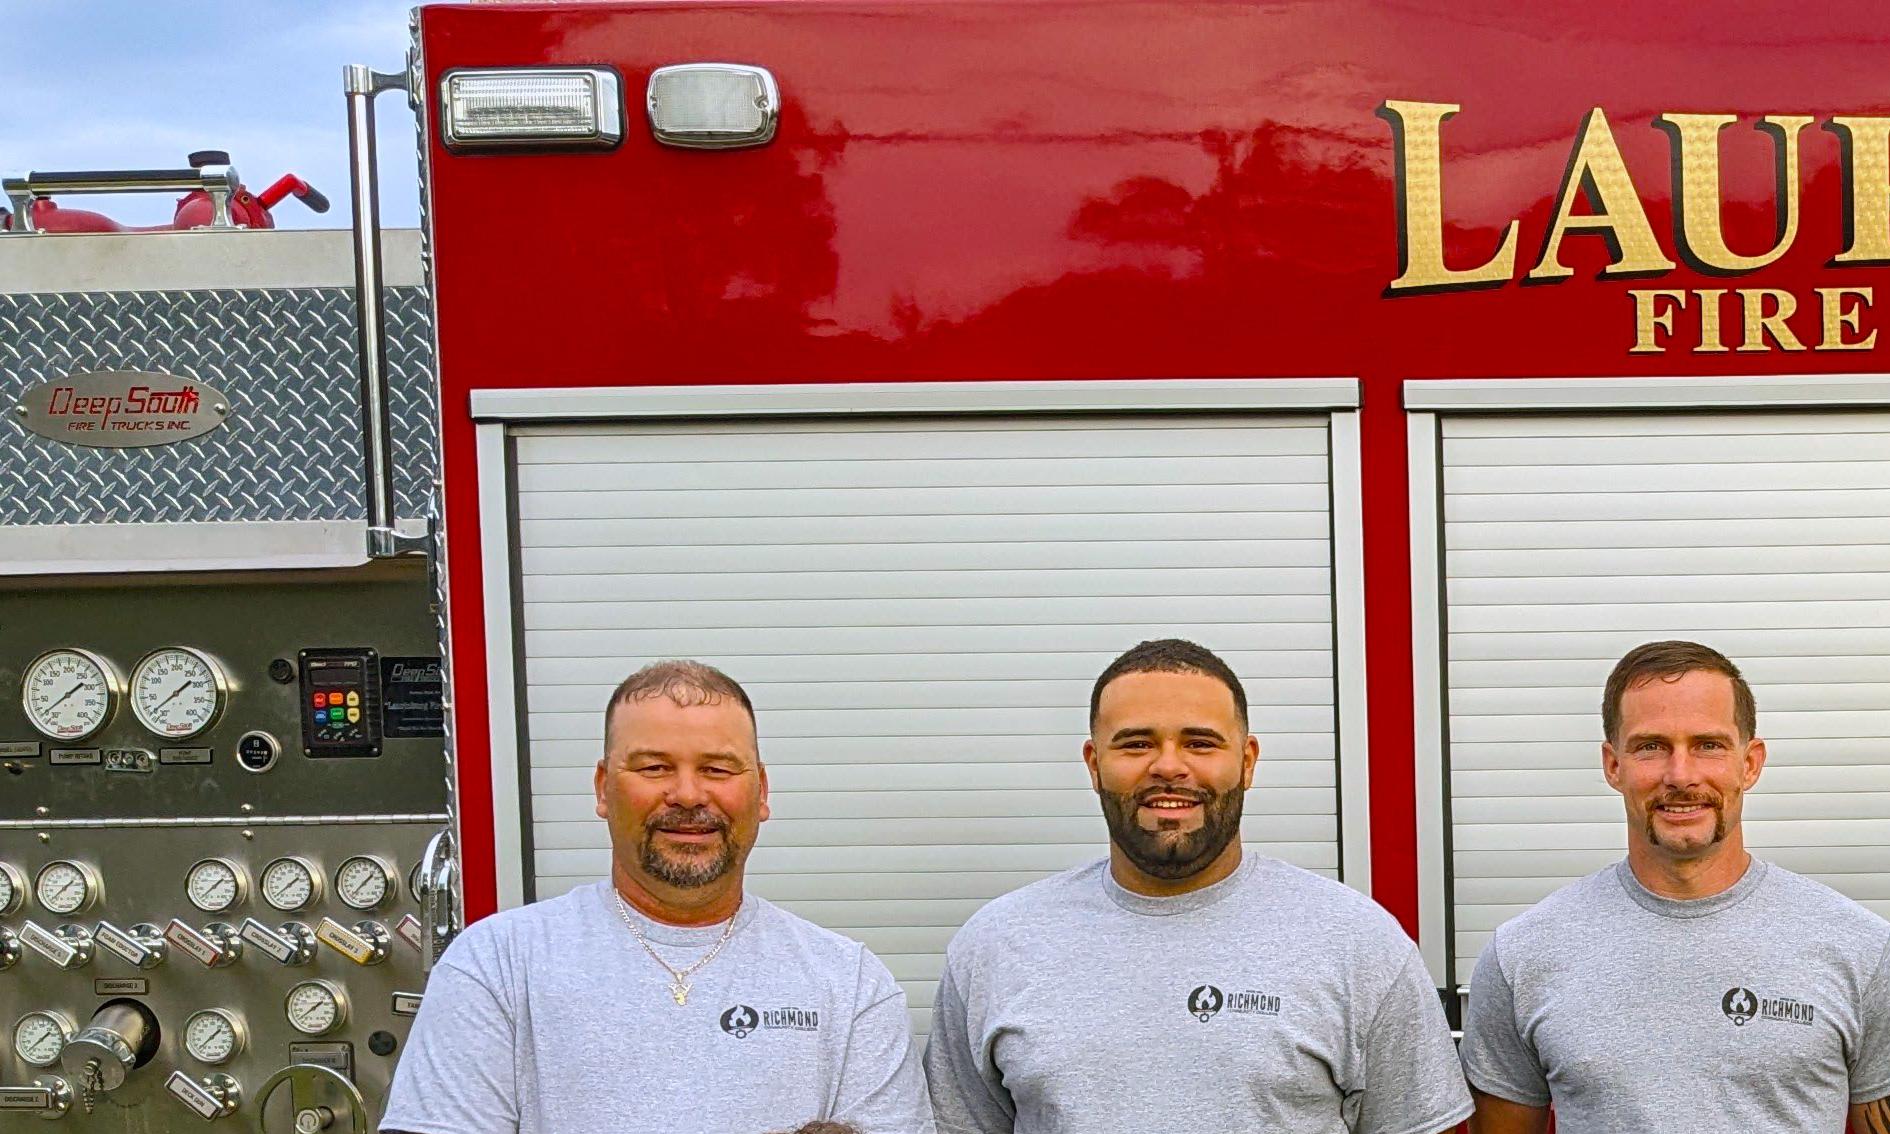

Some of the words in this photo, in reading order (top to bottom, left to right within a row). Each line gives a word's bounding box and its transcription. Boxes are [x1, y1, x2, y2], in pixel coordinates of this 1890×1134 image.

[1628, 286, 1878, 355] FIRE
[48, 387, 122, 430] Deep
[124, 386, 199, 414] South
[68, 422, 95, 431] FIRE
[111, 421, 165, 431] TRUCKS
[167, 420, 191, 431] INC.
[1227, 993, 1280, 1012] RICHMOND
[1762, 999, 1814, 1021] RICHMOND
[763, 1011, 818, 1027] RICHMOND
